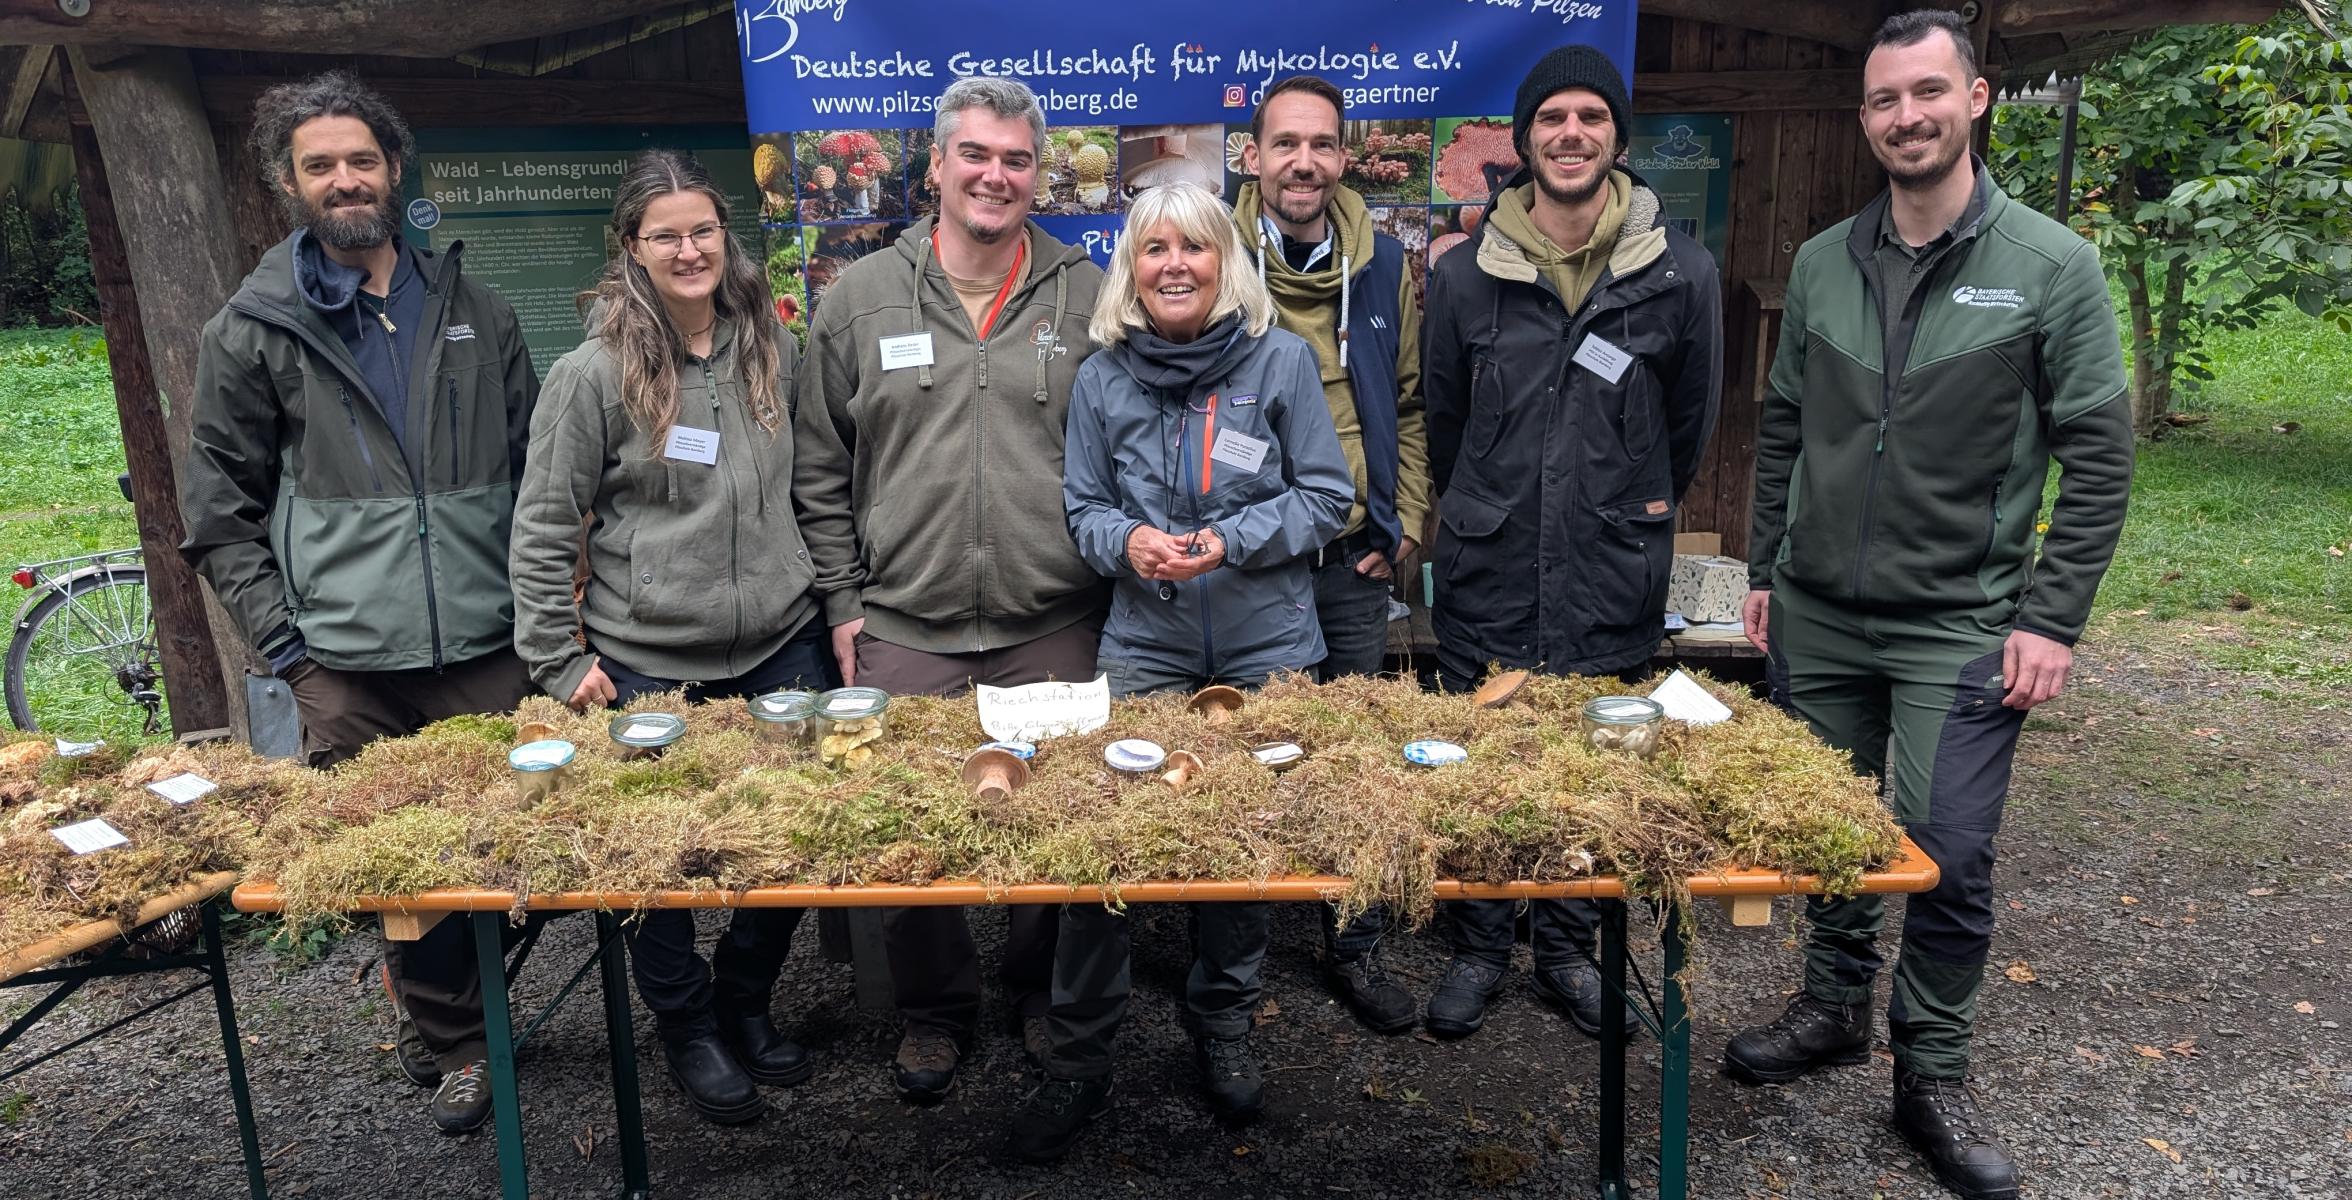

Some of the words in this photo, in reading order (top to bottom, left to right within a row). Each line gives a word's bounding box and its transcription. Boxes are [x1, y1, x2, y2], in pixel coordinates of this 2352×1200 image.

[790, 51, 934, 78] Deutsche
[947, 43, 1156, 82] Gesellschaft
[1171, 42, 1222, 82] für
[1236, 42, 1400, 92] Mykologie
[1413, 40, 1461, 70] e.V.
[430, 162, 479, 178] Wald
[502, 160, 628, 179] Lebensgrundl
[434, 186, 471, 204] seit
[476, 185, 612, 205] Jahrhunderten
[412, 203, 433, 216] Denk
[418, 213, 435, 225] mal!
[1082, 229, 1119, 255] Pil
[1975, 294, 2024, 303] STAATSFORSTEN
[1977, 288, 2017, 296] BAYERISCHE
[987, 688, 1101, 706] Riechstation
